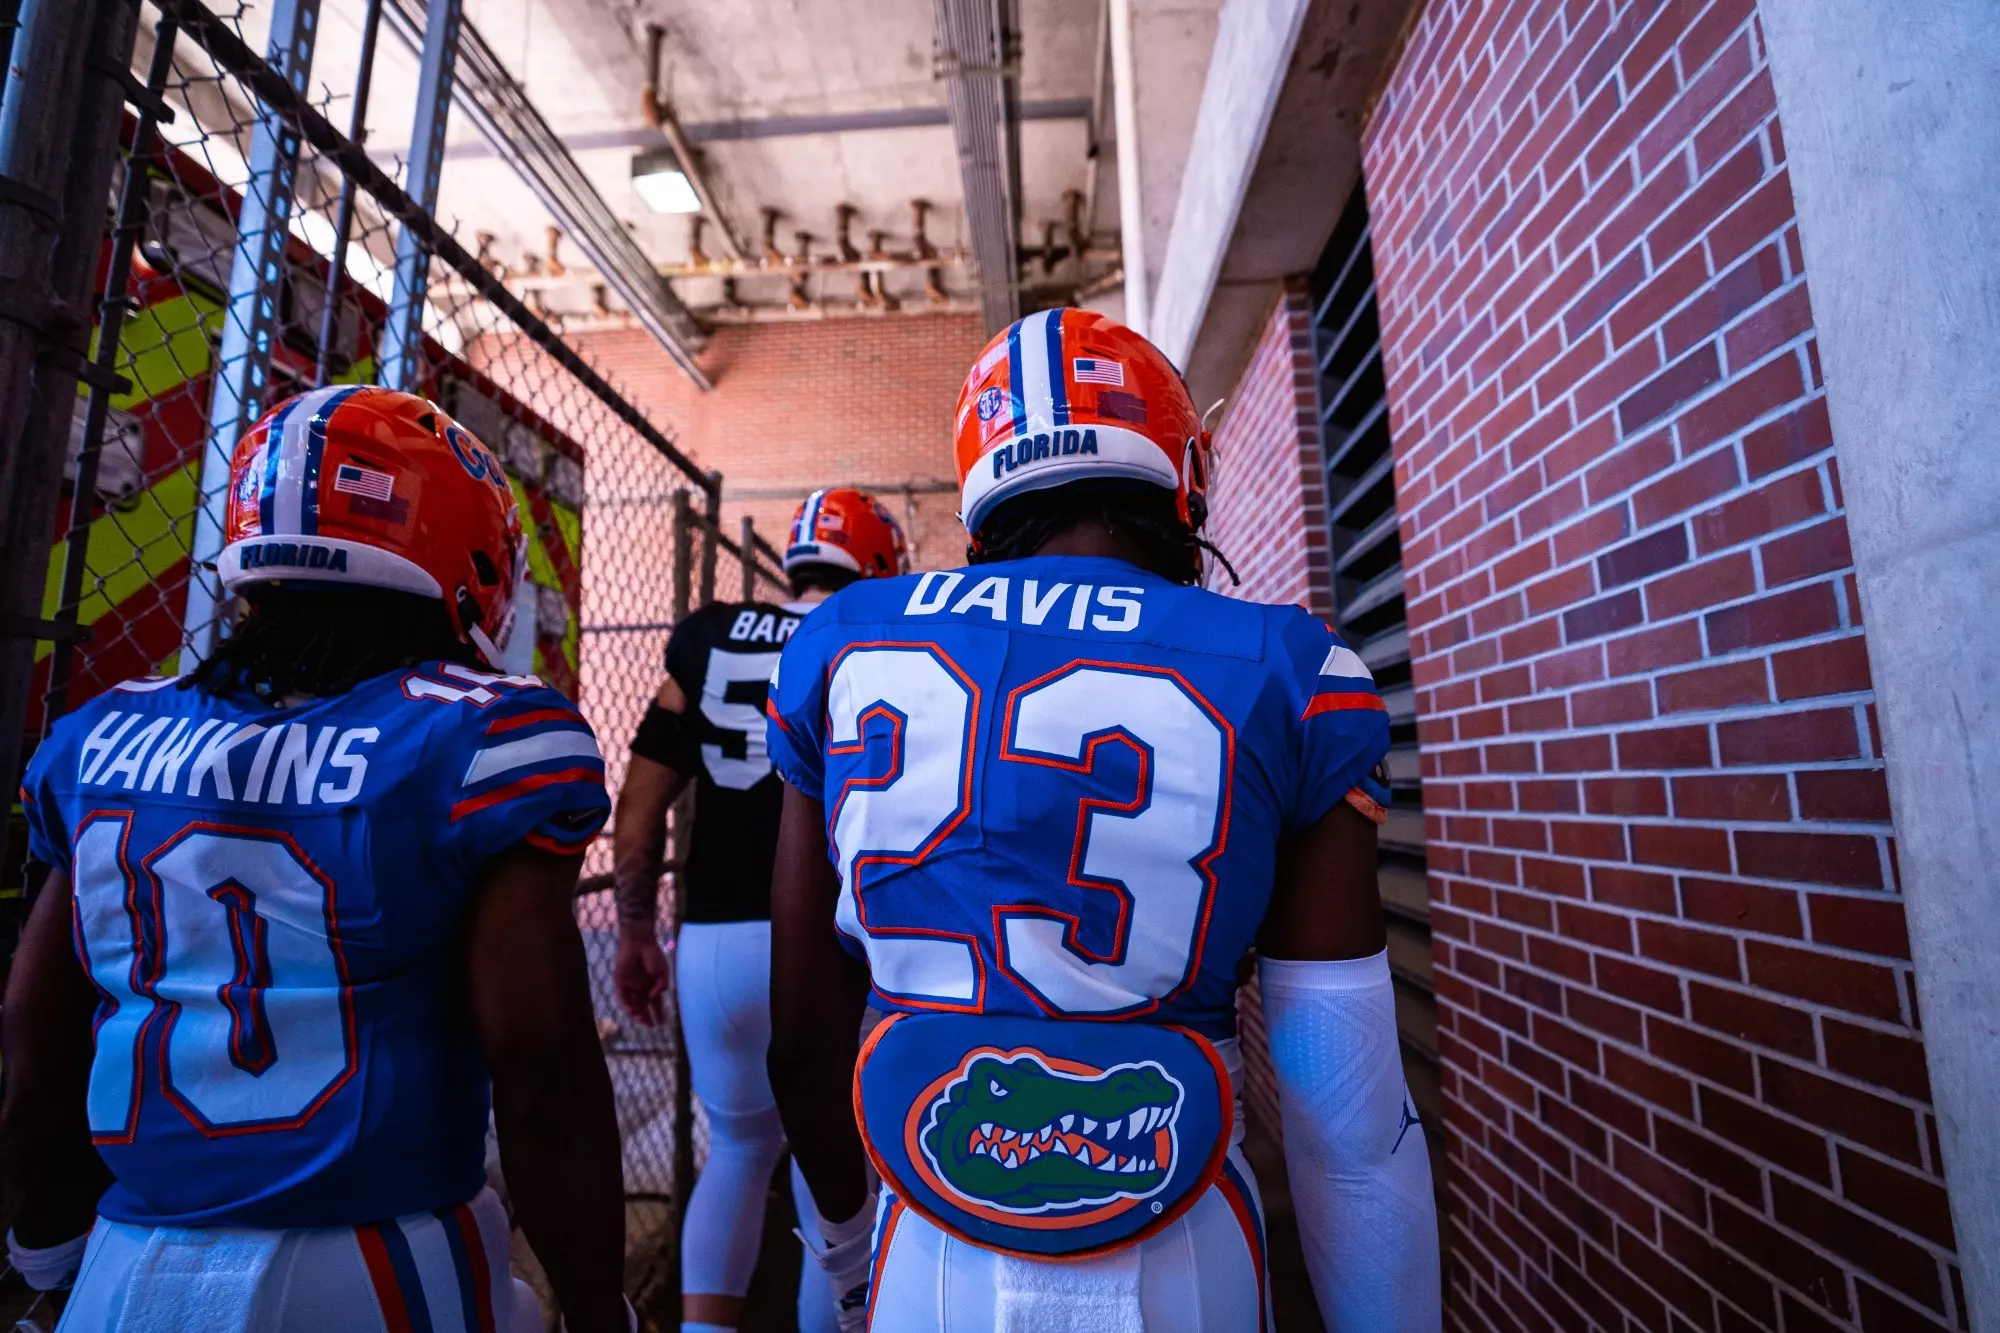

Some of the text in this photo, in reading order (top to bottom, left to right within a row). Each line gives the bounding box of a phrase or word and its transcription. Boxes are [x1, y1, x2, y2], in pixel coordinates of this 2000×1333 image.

[993, 429, 1098, 479] FLORIDA
[240, 544, 347, 573] FLORIDA
[904, 570, 1144, 631] DAVIS
[80, 711, 379, 804] HAWKINS
[826, 641, 1235, 1021] 23
[73, 810, 358, 1144] 10
